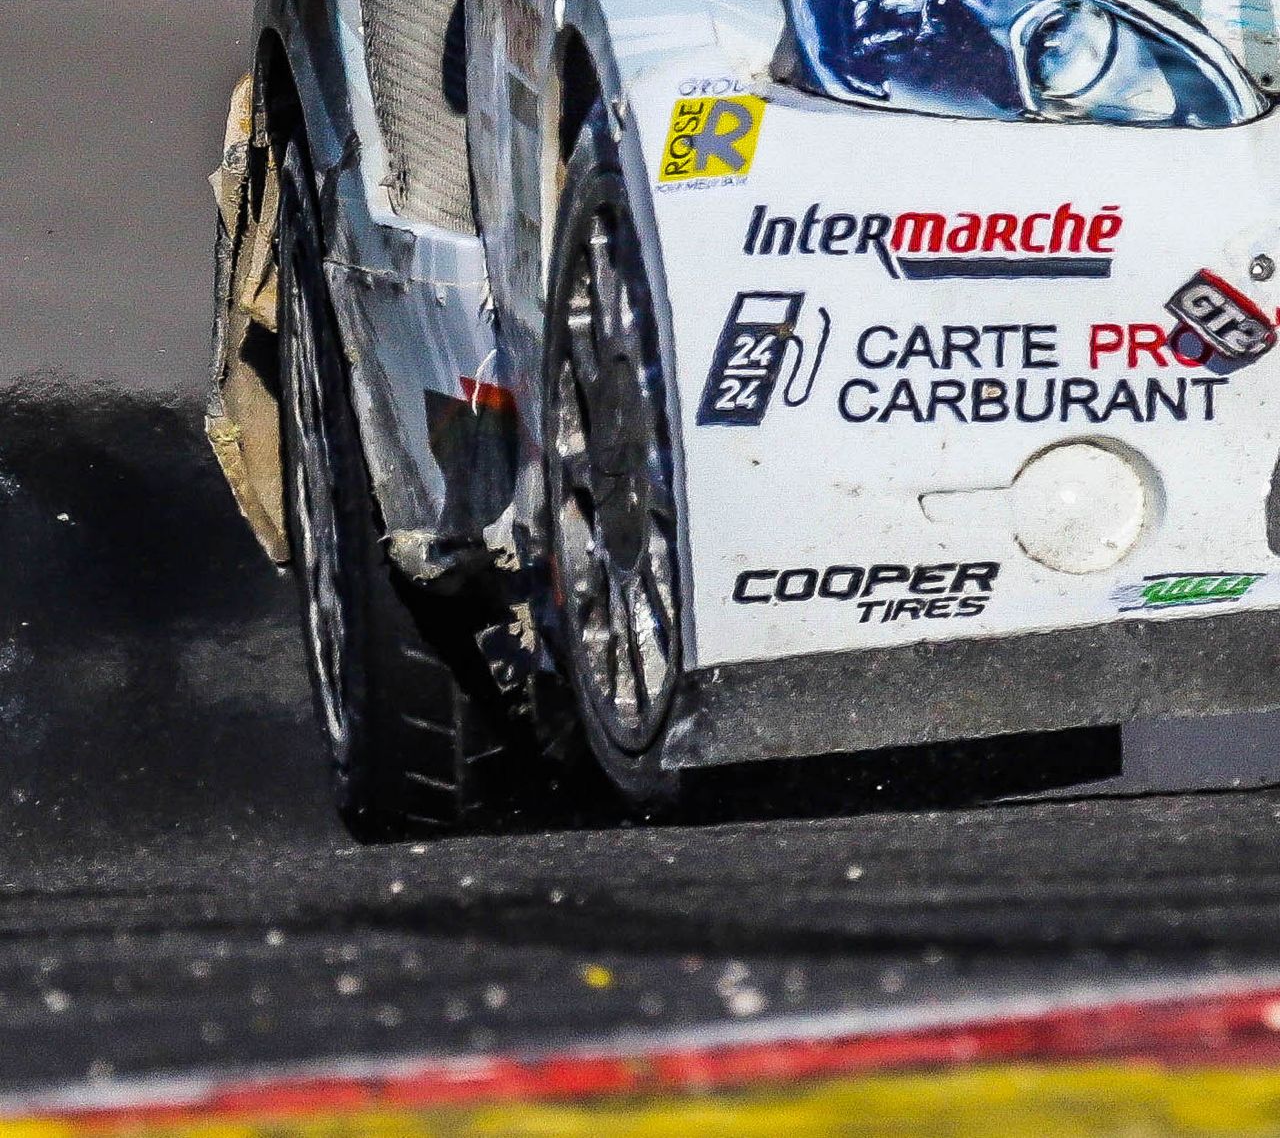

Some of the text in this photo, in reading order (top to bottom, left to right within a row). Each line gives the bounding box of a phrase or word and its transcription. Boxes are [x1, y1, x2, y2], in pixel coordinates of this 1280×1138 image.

[664, 102, 705, 176] ROSE
[726, 333, 778, 366] 24
[856, 322, 1215, 370] CARTE PRO
[713, 379, 763, 411] 24
[837, 375, 1229, 423] CARBURANT
[732, 561, 1000, 606] COOPER
[855, 596, 986, 624] TIRES
